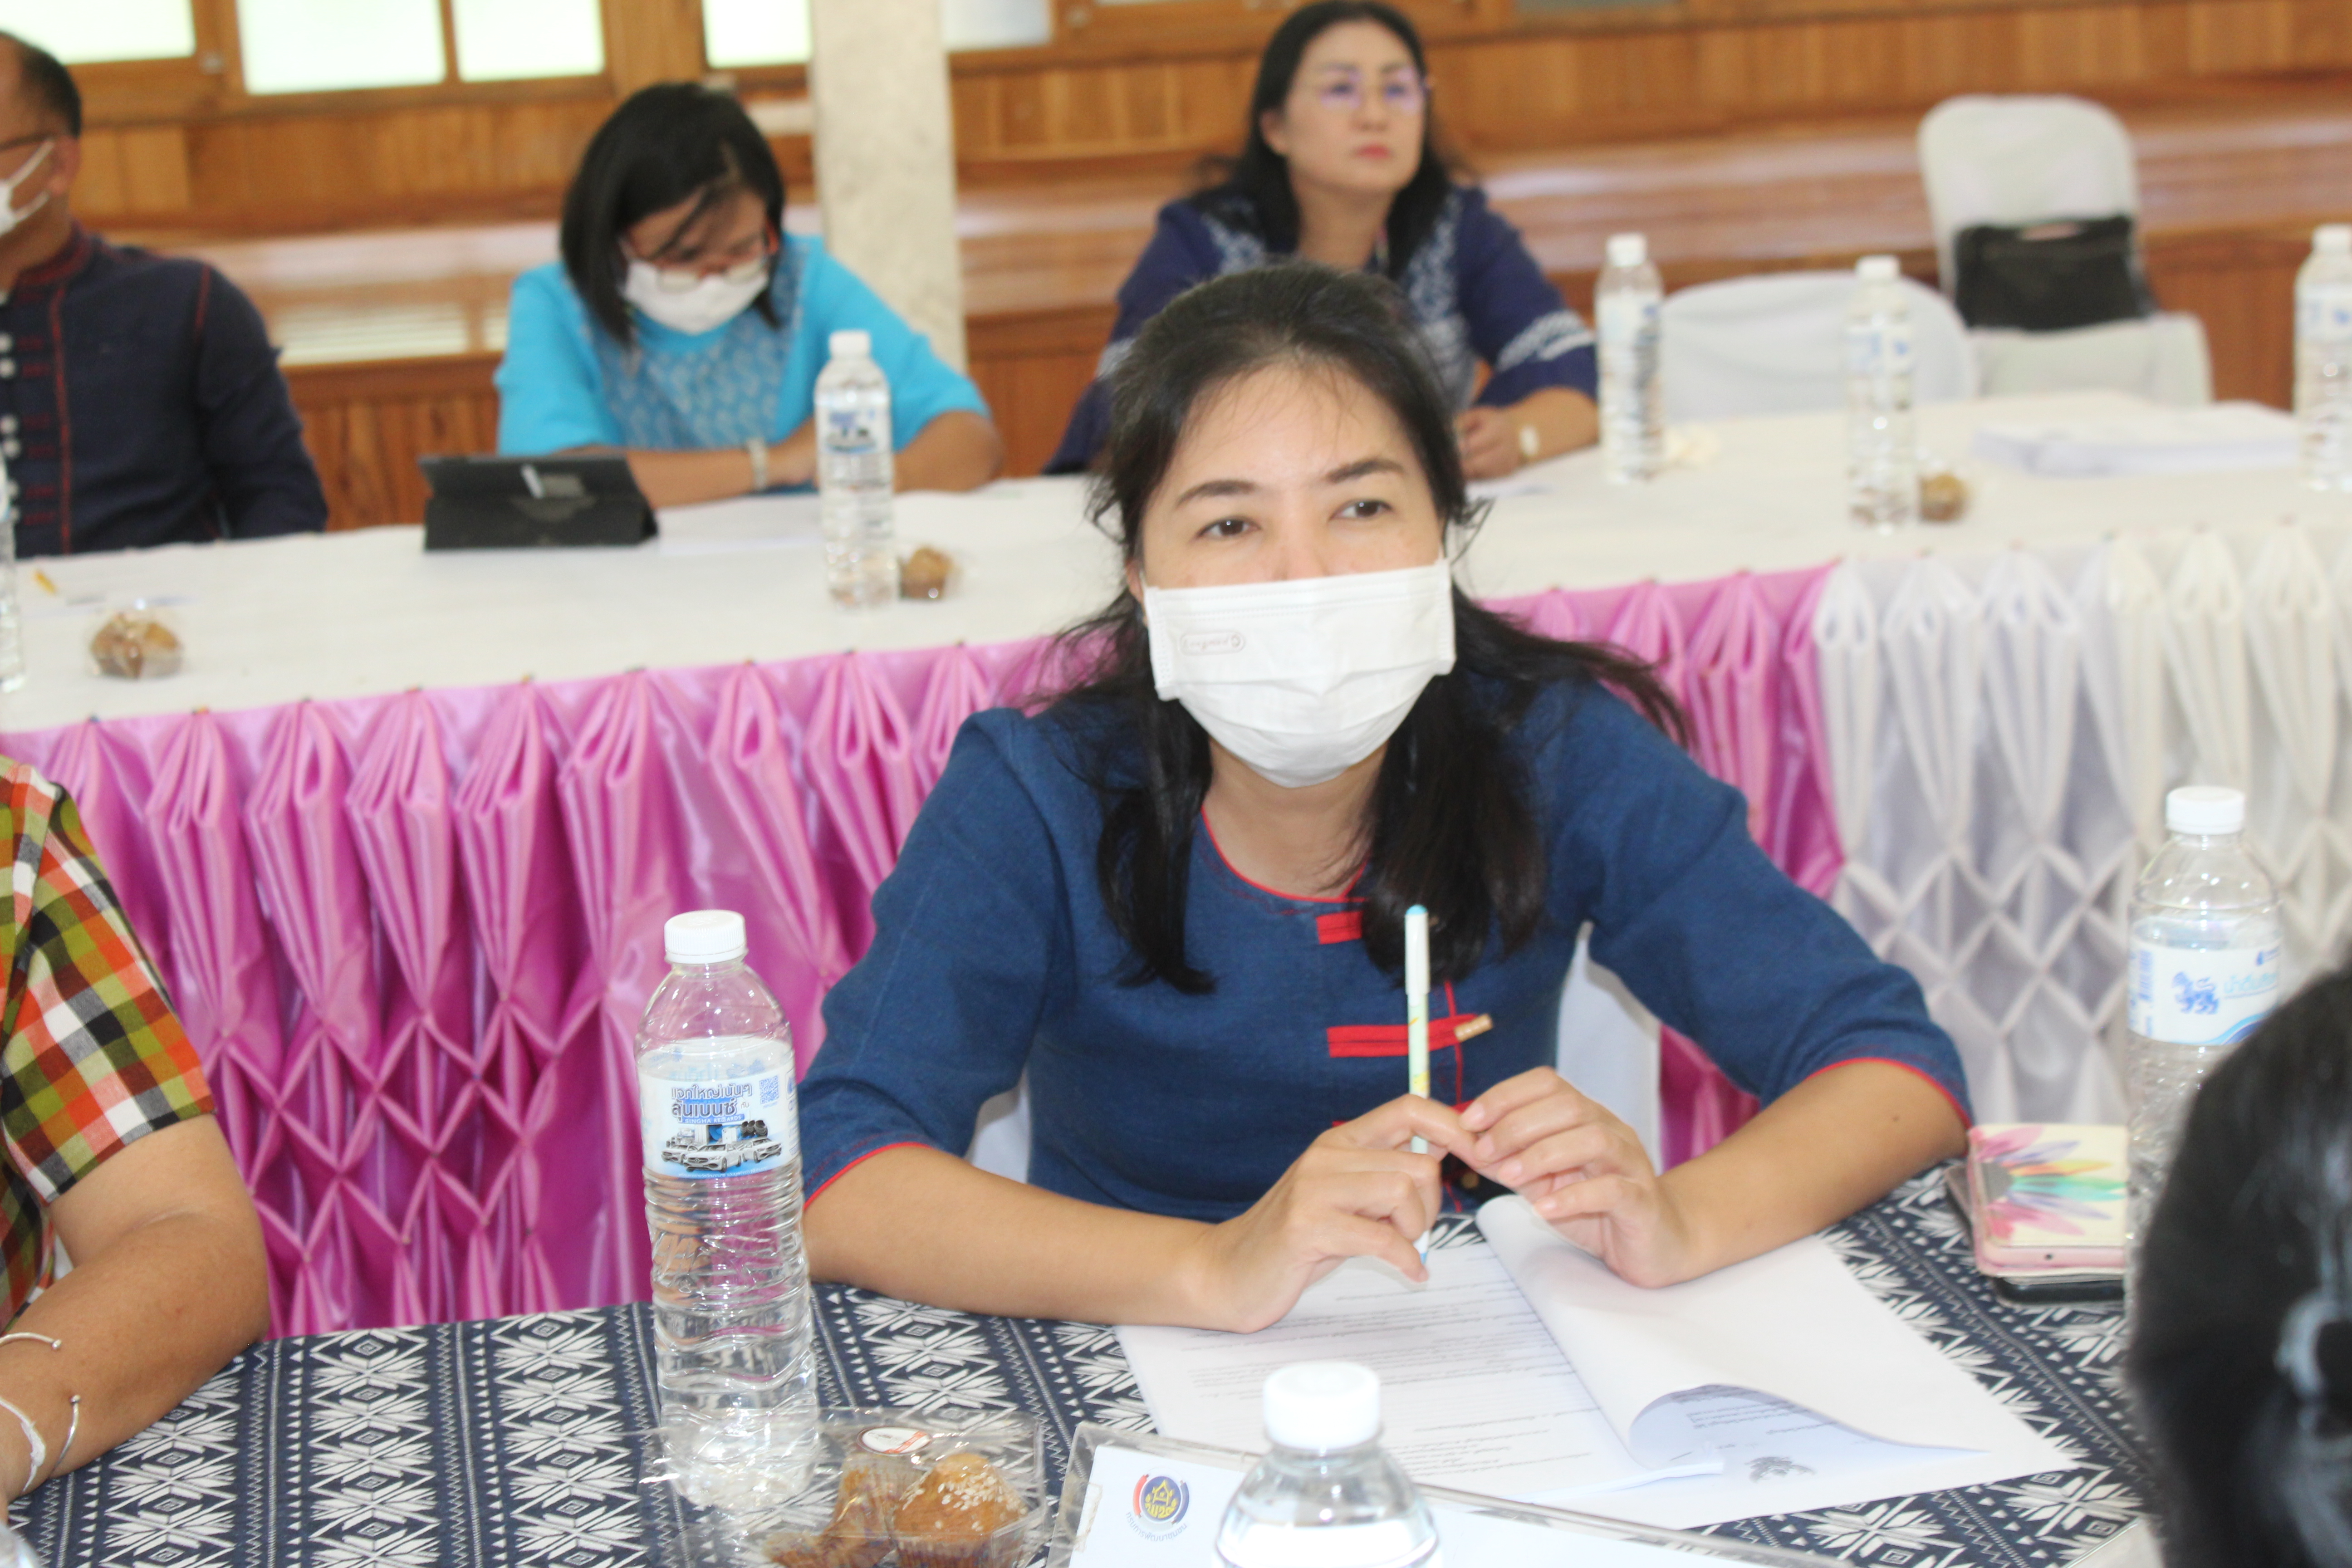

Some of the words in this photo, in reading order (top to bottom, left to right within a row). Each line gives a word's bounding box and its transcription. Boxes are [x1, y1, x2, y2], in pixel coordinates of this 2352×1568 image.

[671, 1098, 737, 1122] ลุ้นเบนซ์
[1125, 1512, 1187, 1542] กรมการพัฒนาชุมชน
